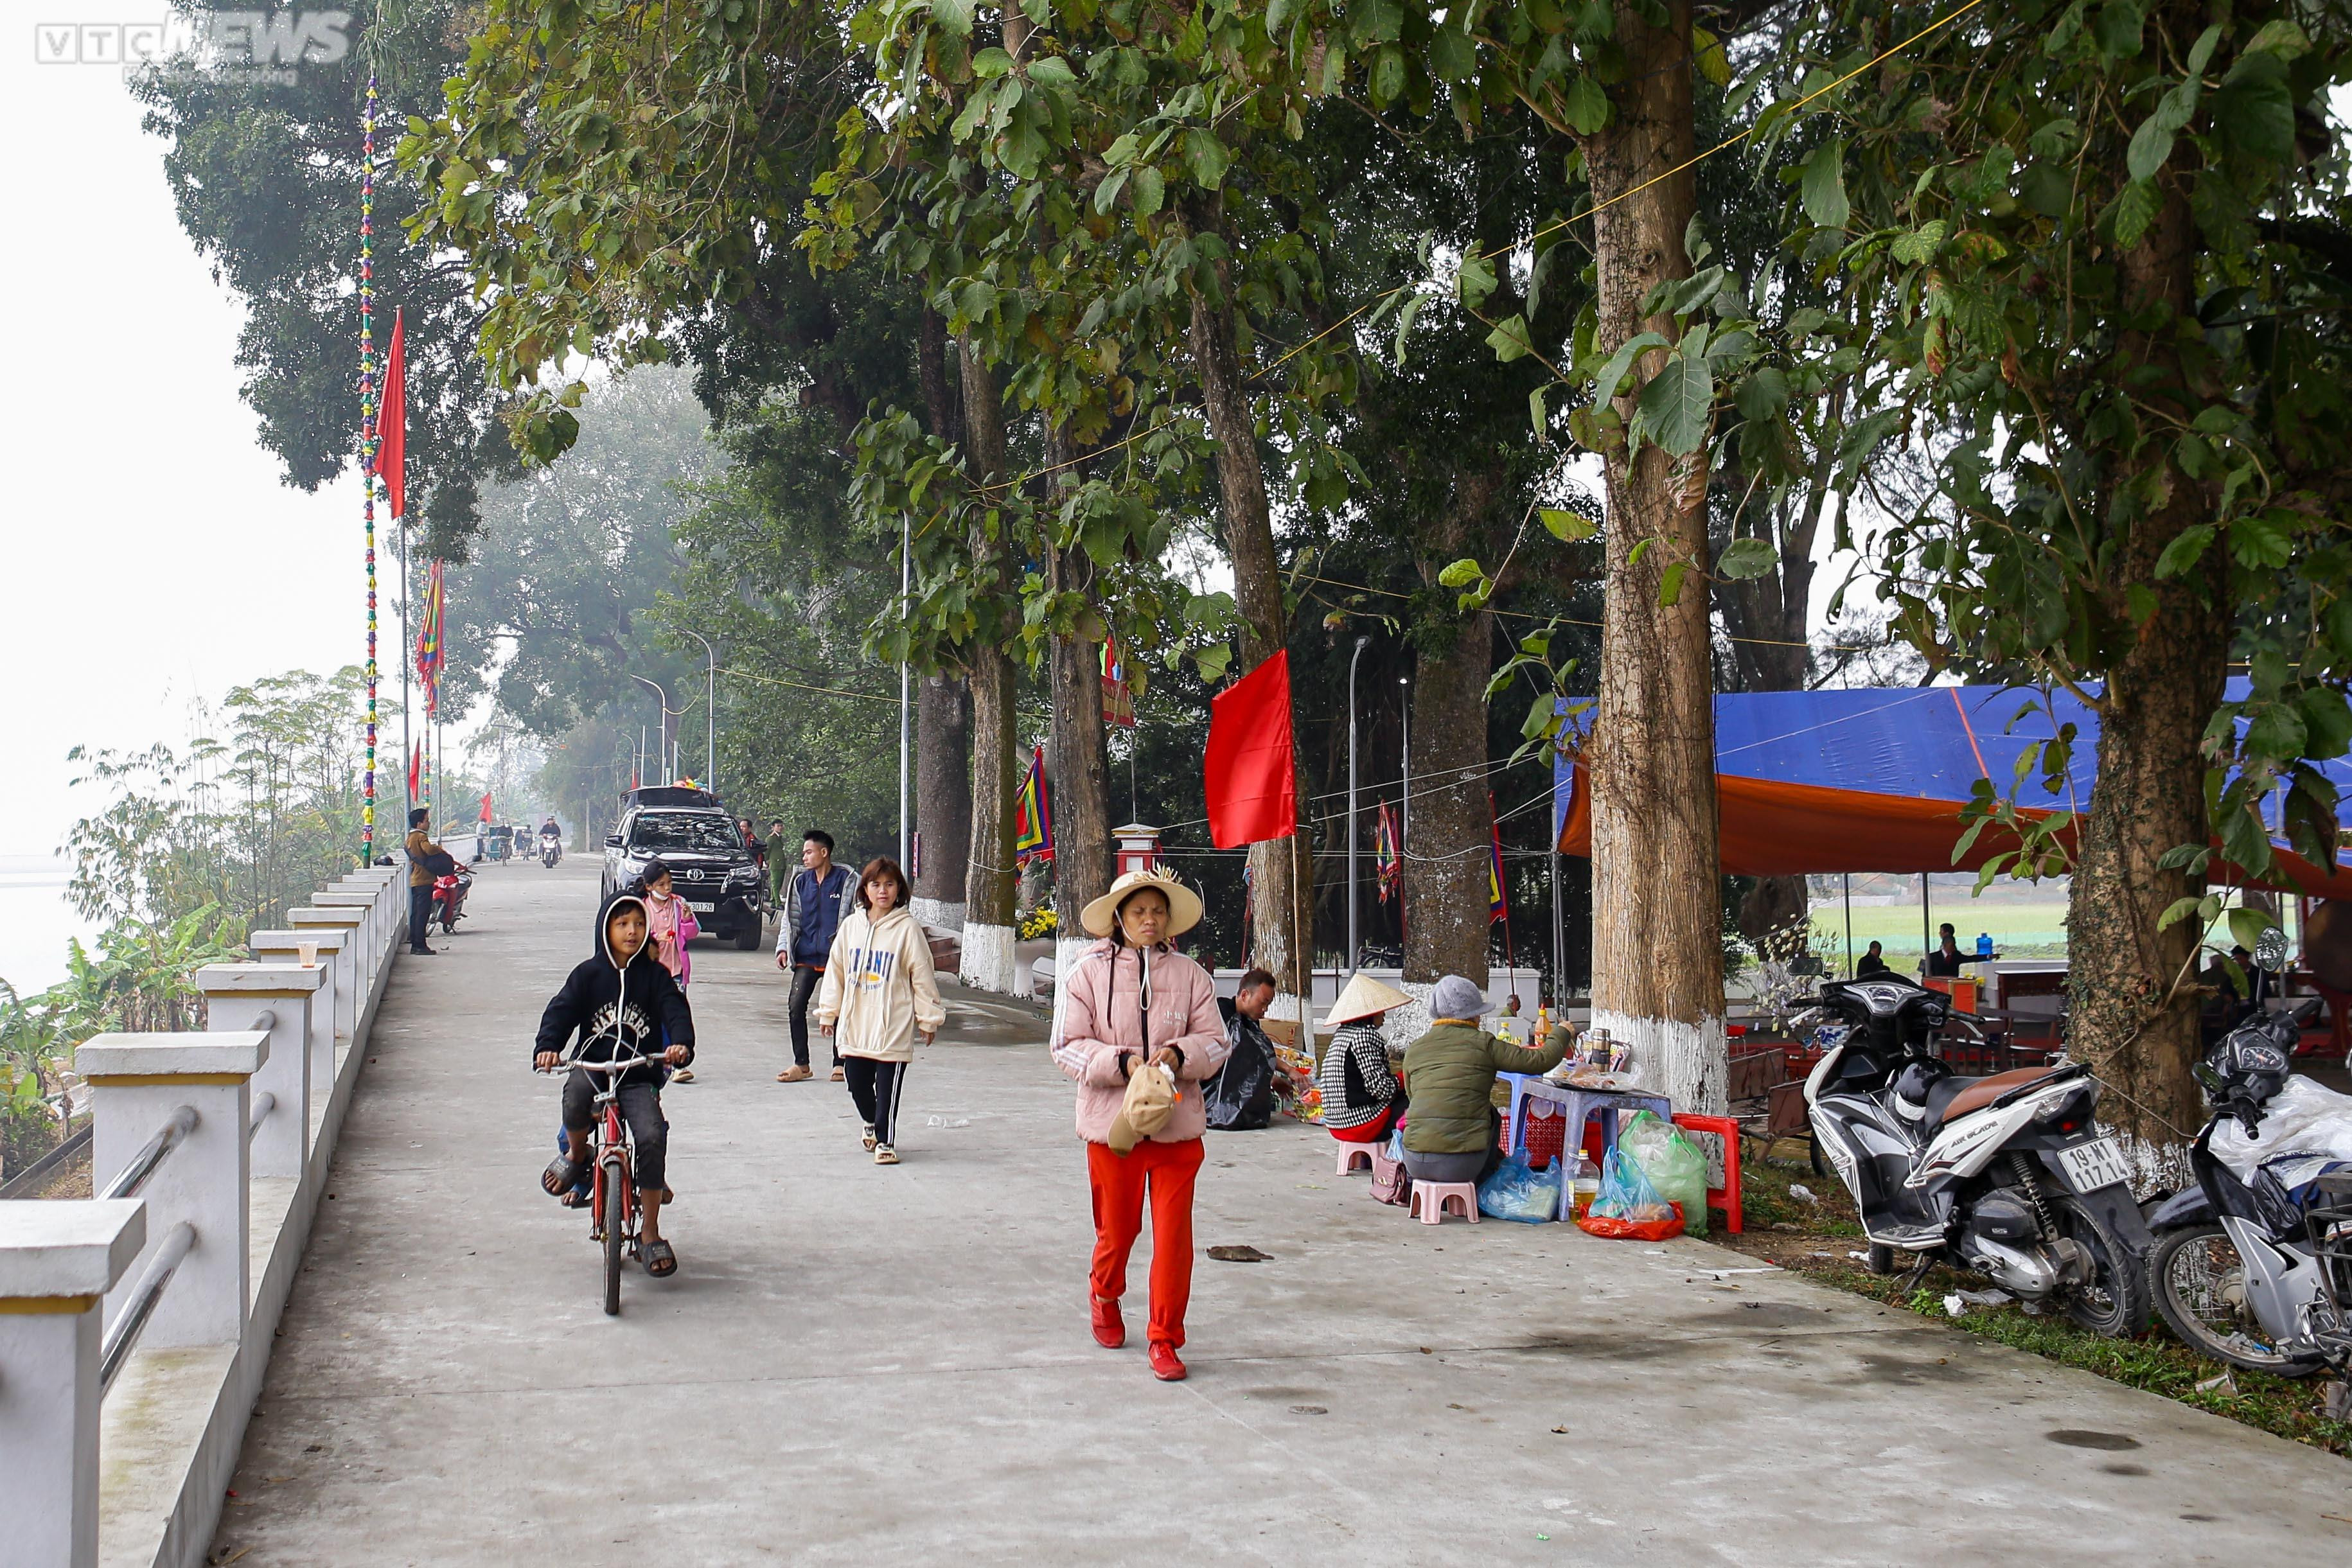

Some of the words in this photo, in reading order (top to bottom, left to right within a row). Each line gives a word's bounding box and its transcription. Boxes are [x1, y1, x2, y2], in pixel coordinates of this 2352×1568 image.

[1950, 1136, 1967, 1148] AIR
[2069, 1141, 2112, 1168] 19-N1
[2075, 1159, 2128, 1190] 117.14
